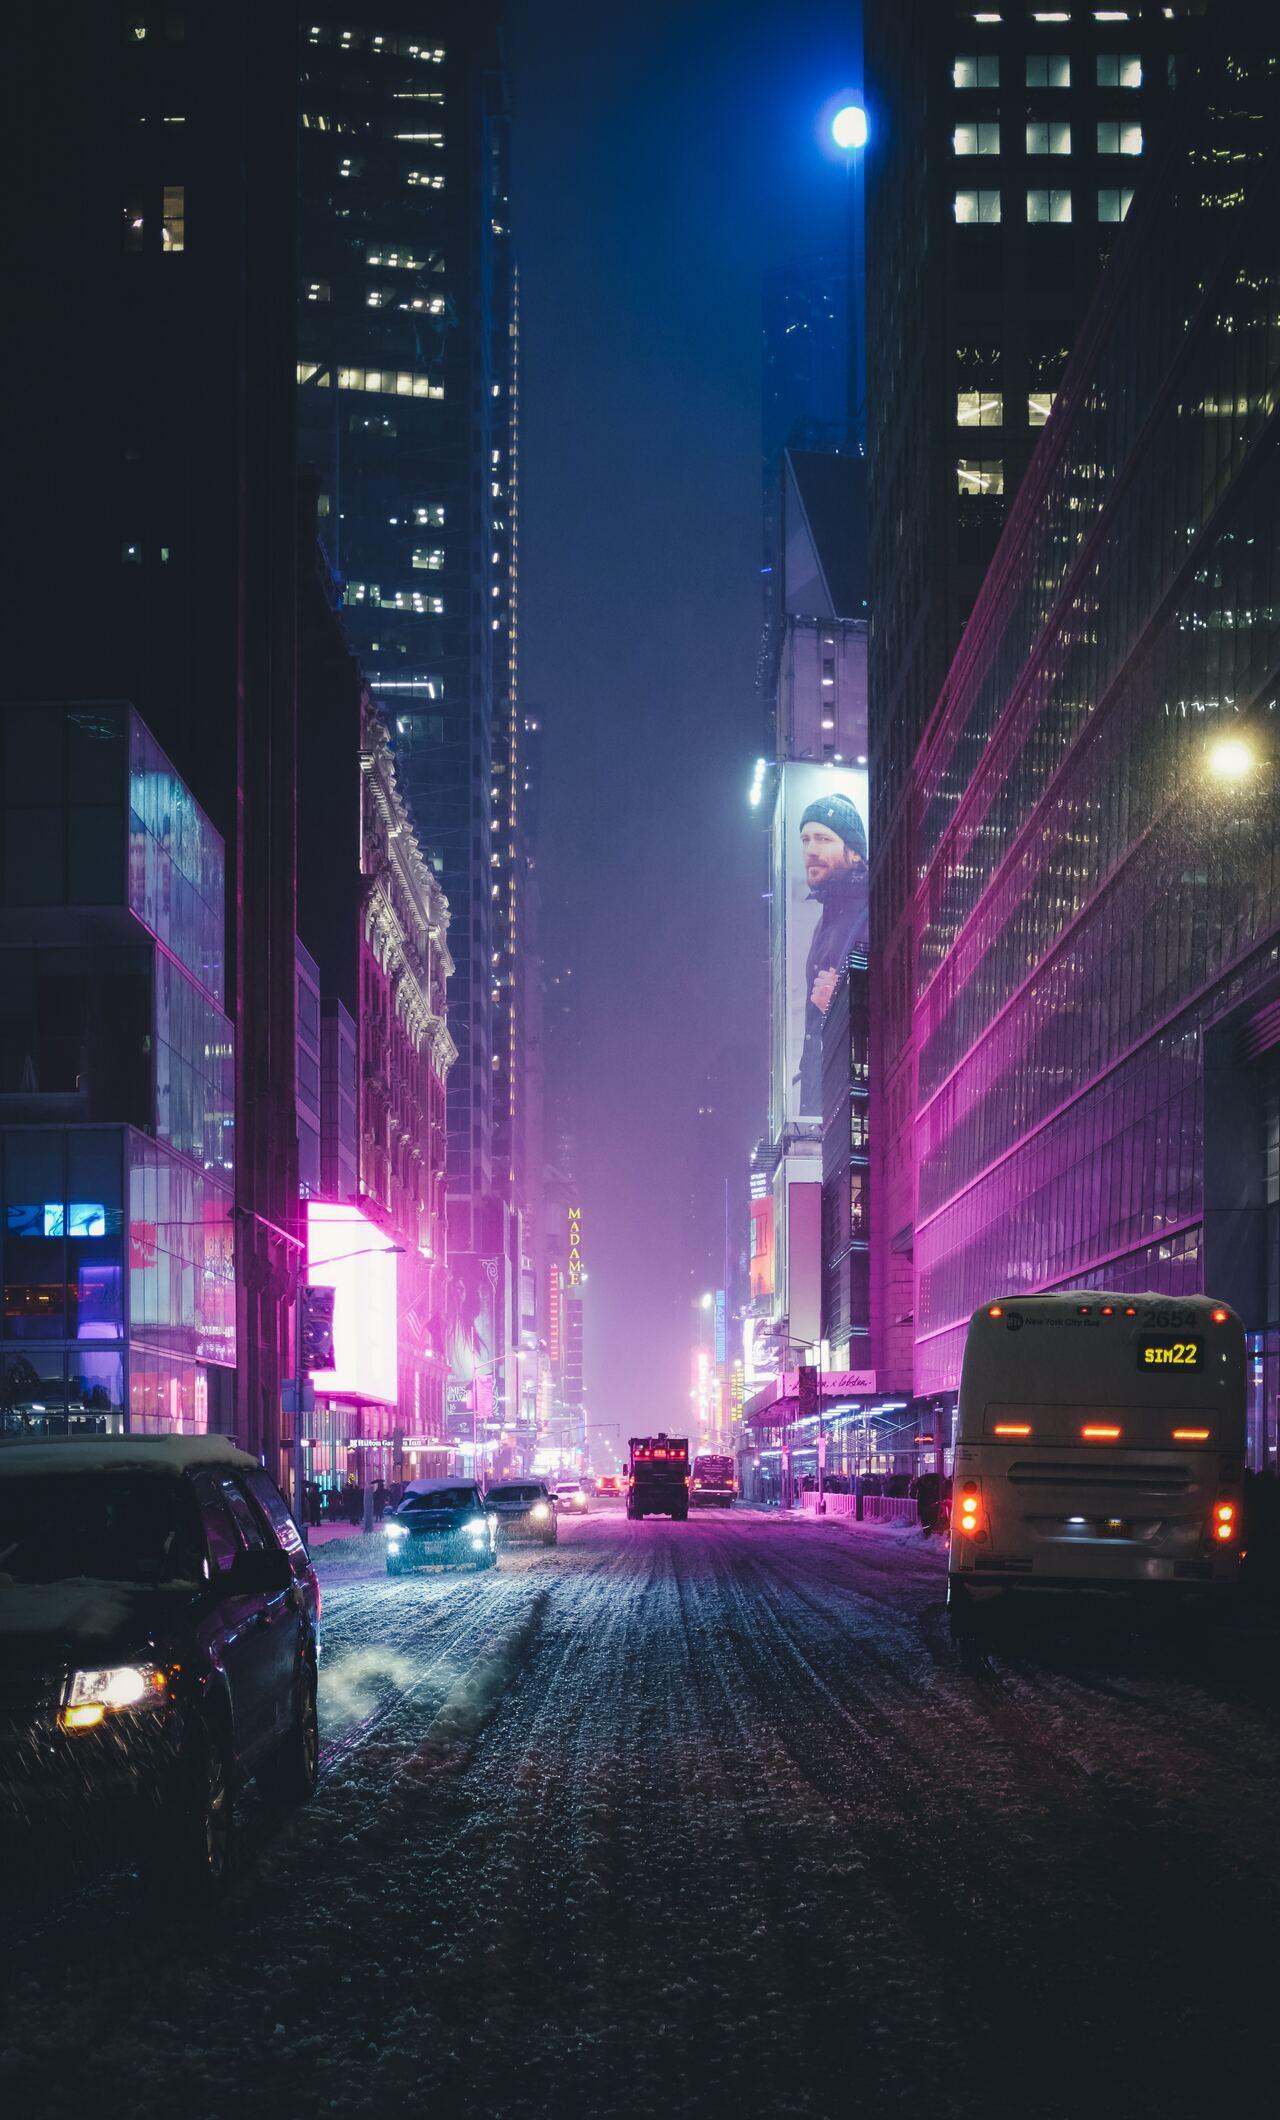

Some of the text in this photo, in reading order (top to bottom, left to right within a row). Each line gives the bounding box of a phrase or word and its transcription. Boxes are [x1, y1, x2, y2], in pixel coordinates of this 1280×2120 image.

[568, 1207, 582, 1285] MADAME
[1143, 1310, 1198, 1329] 2654
[1144, 1343, 1198, 1364] SIM22
[358, 1439, 382, 1447] Hilton
